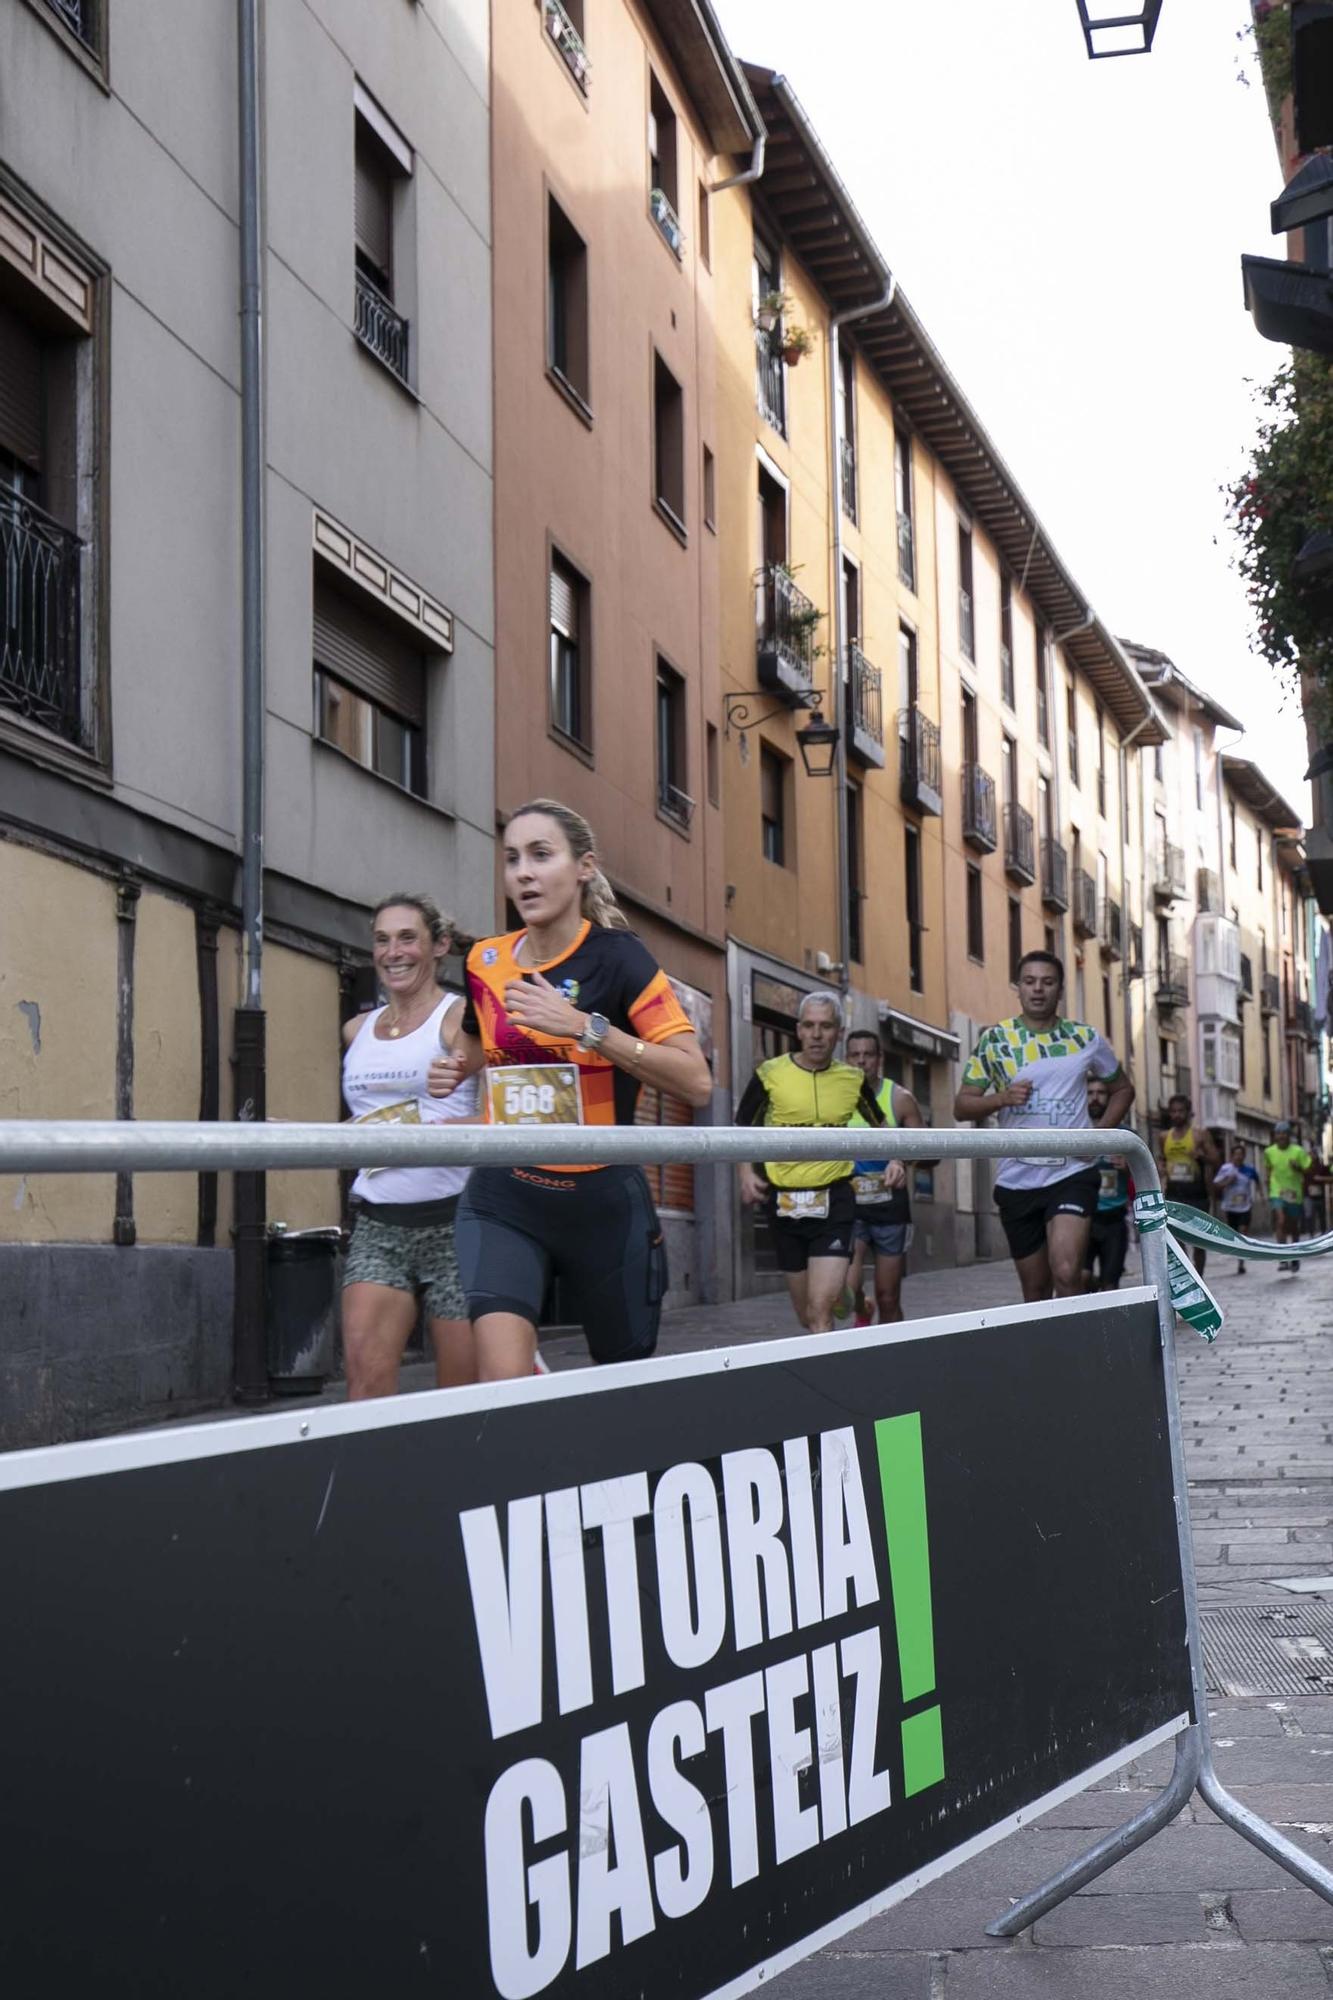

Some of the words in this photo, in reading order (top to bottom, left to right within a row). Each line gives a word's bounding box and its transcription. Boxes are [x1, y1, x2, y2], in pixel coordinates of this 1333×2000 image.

[505, 1083, 555, 1114] 568
[512, 1167, 575, 1188] WONG
[459, 1426, 880, 1740] VITORIA
[484, 1626, 892, 2000] GASTEIZ
